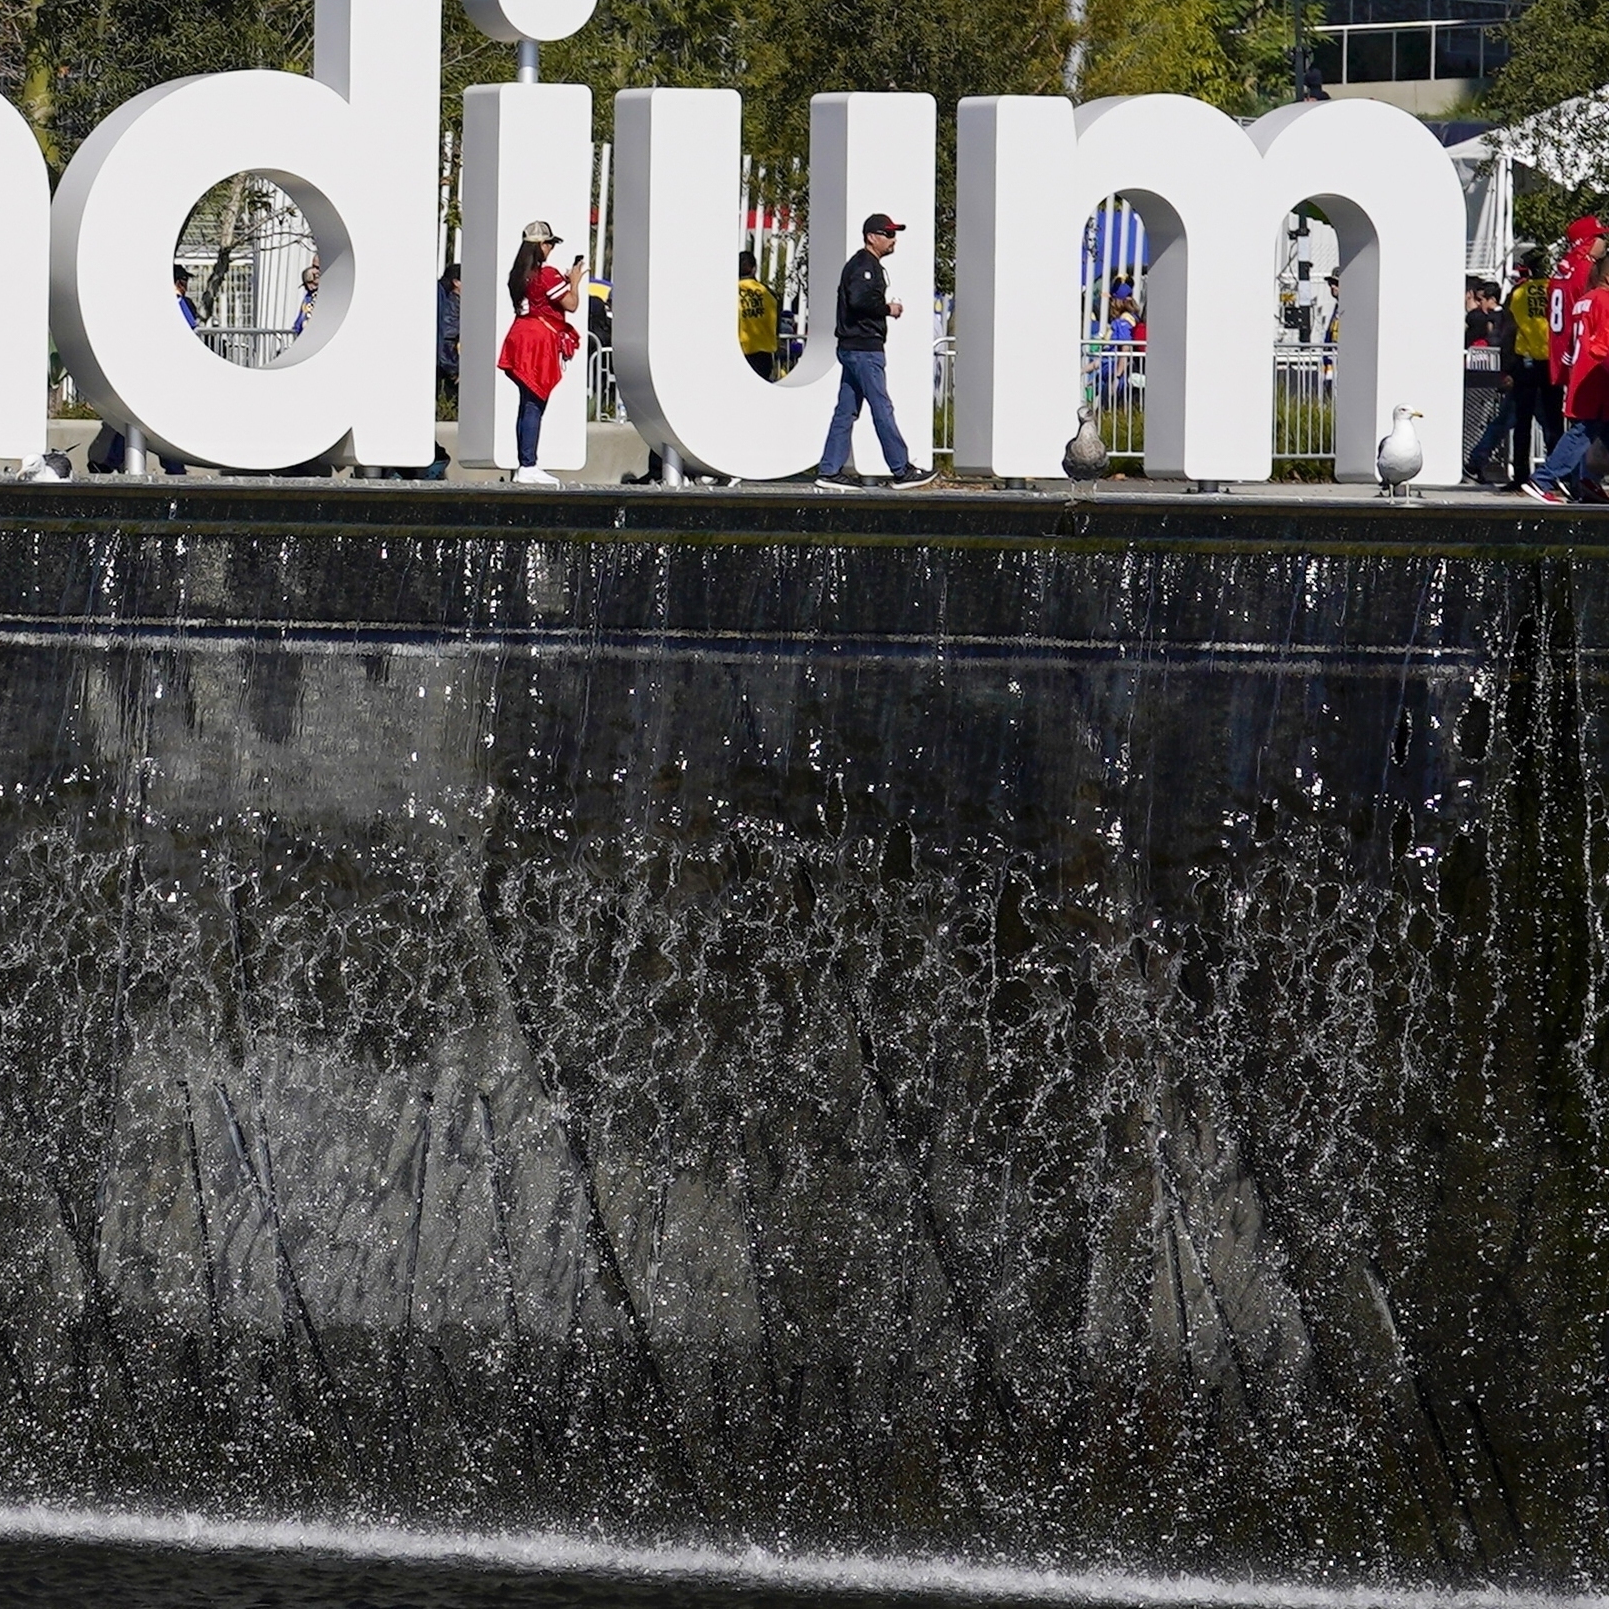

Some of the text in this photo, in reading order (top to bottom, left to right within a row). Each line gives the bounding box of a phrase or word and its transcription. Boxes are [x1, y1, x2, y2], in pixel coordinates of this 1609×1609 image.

[1527, 284, 1547, 296] CS
[1527, 296, 1548, 308] EVE
[1527, 307, 1546, 318] STA
